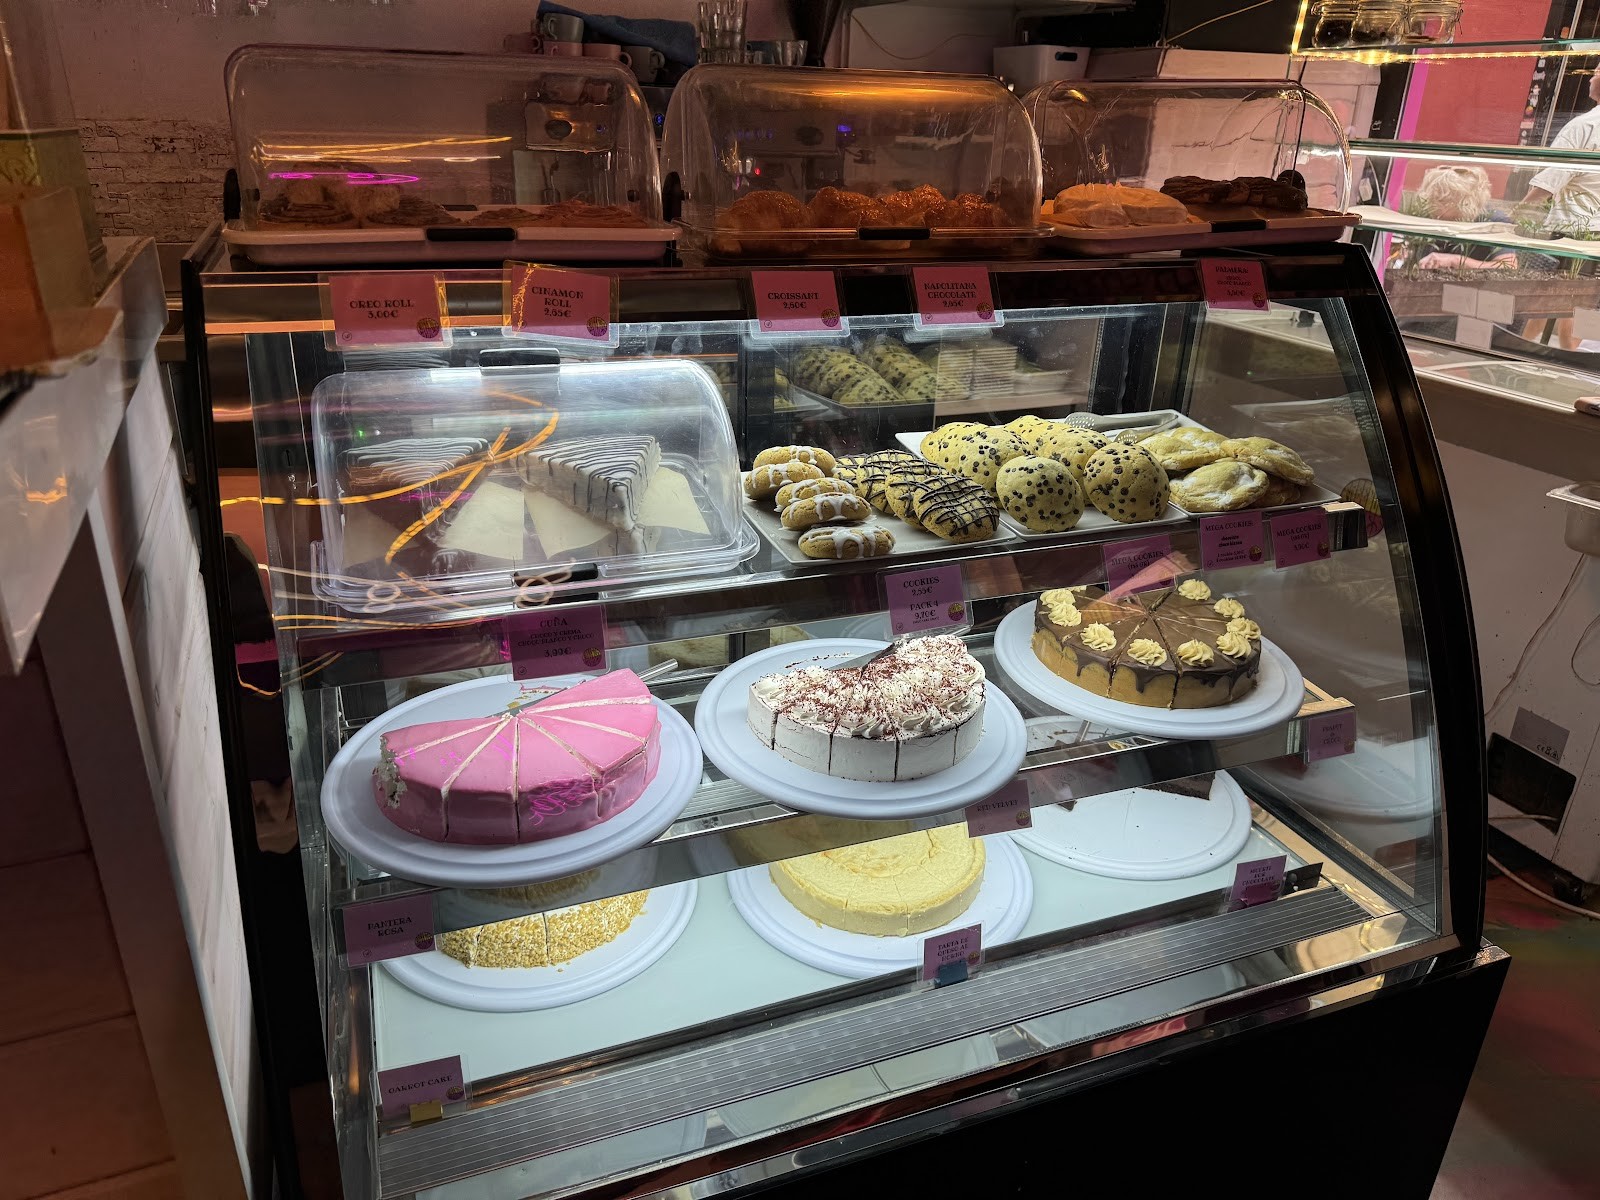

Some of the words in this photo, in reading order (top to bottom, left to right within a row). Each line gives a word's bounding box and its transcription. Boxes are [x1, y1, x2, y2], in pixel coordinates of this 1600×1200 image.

[531, 286, 584, 299] CINAMON
[767, 292, 819, 300] CROISSANT
[927, 291, 976, 299] CHOCOLATE
[384, 299, 414, 308] ROLL
[544, 298, 571, 308] ROLL
[1133, 549, 1164, 561] COOKIES
[903, 576, 940, 588] COOKIES
[910, 601, 932, 611] PACK
[367, 916, 412, 930] PANTERA
[377, 927, 404, 937] ROSA
[937, 940, 959, 951] TARTA
[937, 948, 958, 957] QUESO
[427, 1075, 453, 1086] CAKE
